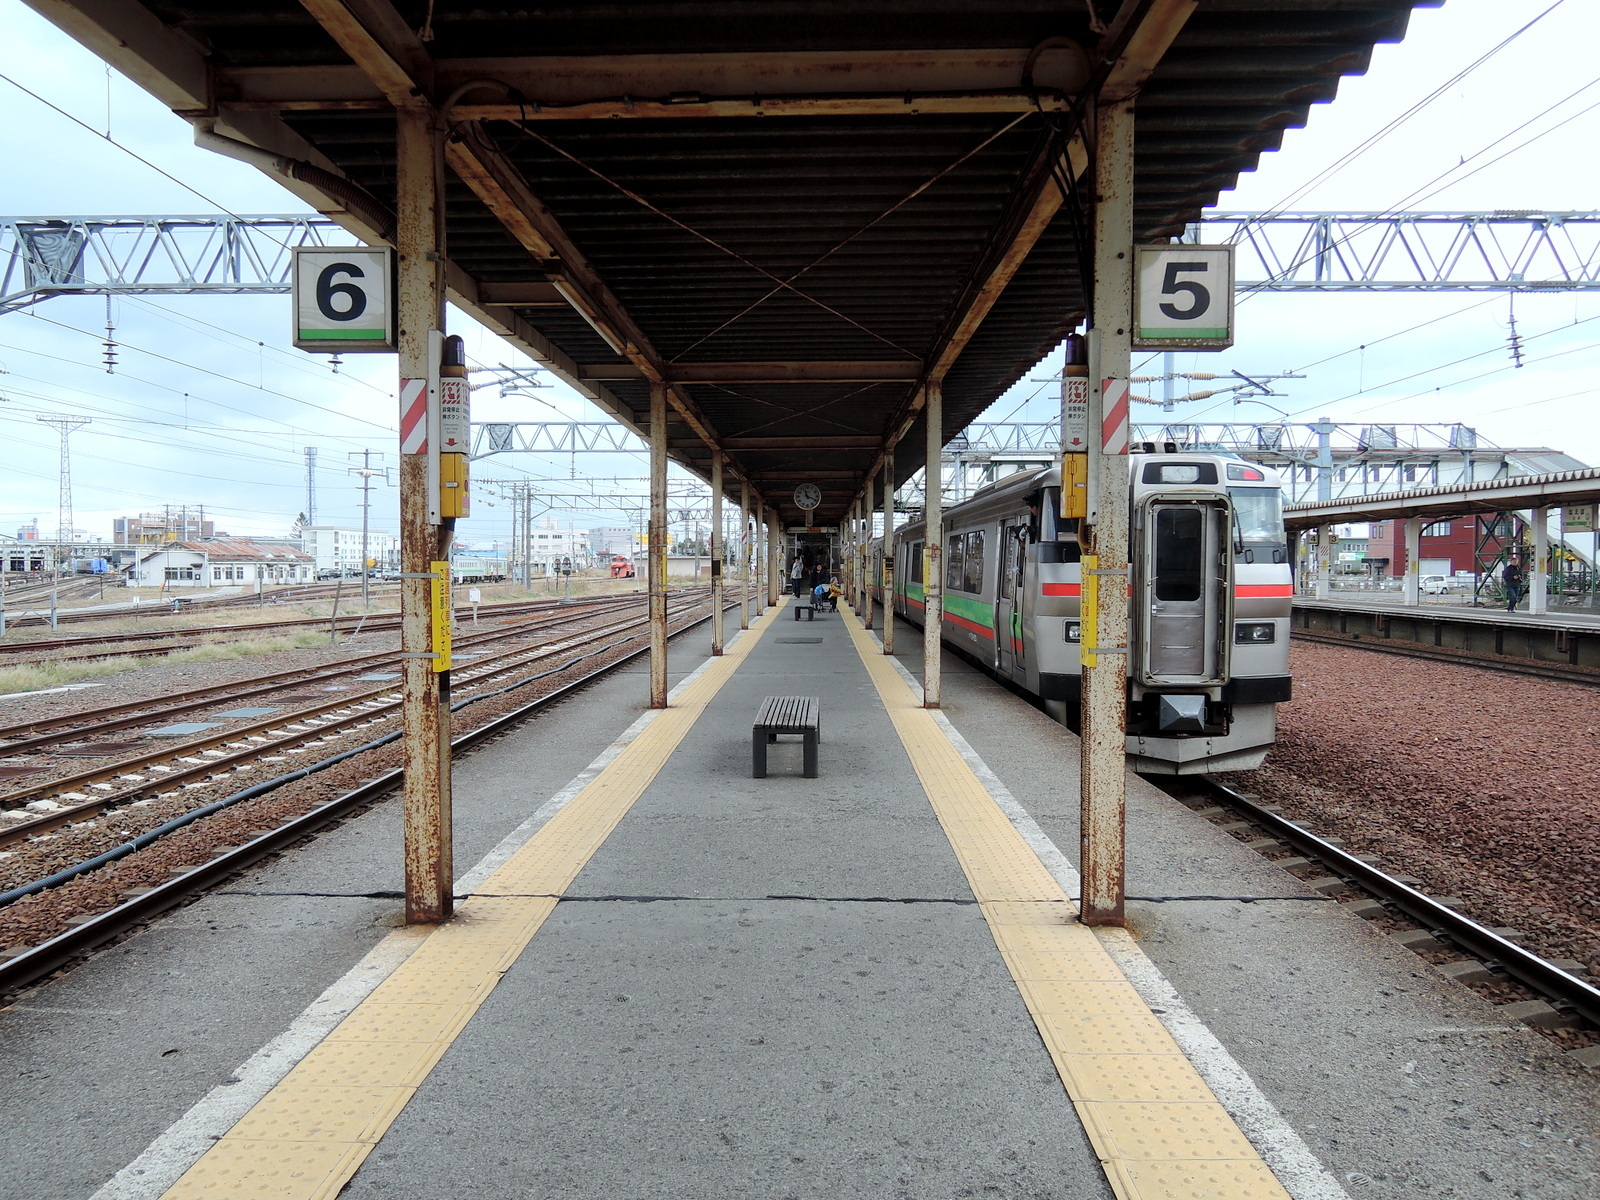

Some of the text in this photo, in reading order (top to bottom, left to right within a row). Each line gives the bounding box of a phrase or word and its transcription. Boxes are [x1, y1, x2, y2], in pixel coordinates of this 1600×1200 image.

[316, 262, 367, 322] 6
[1159, 262, 1211, 321] 5
[1331, 535, 1337, 543] 3
